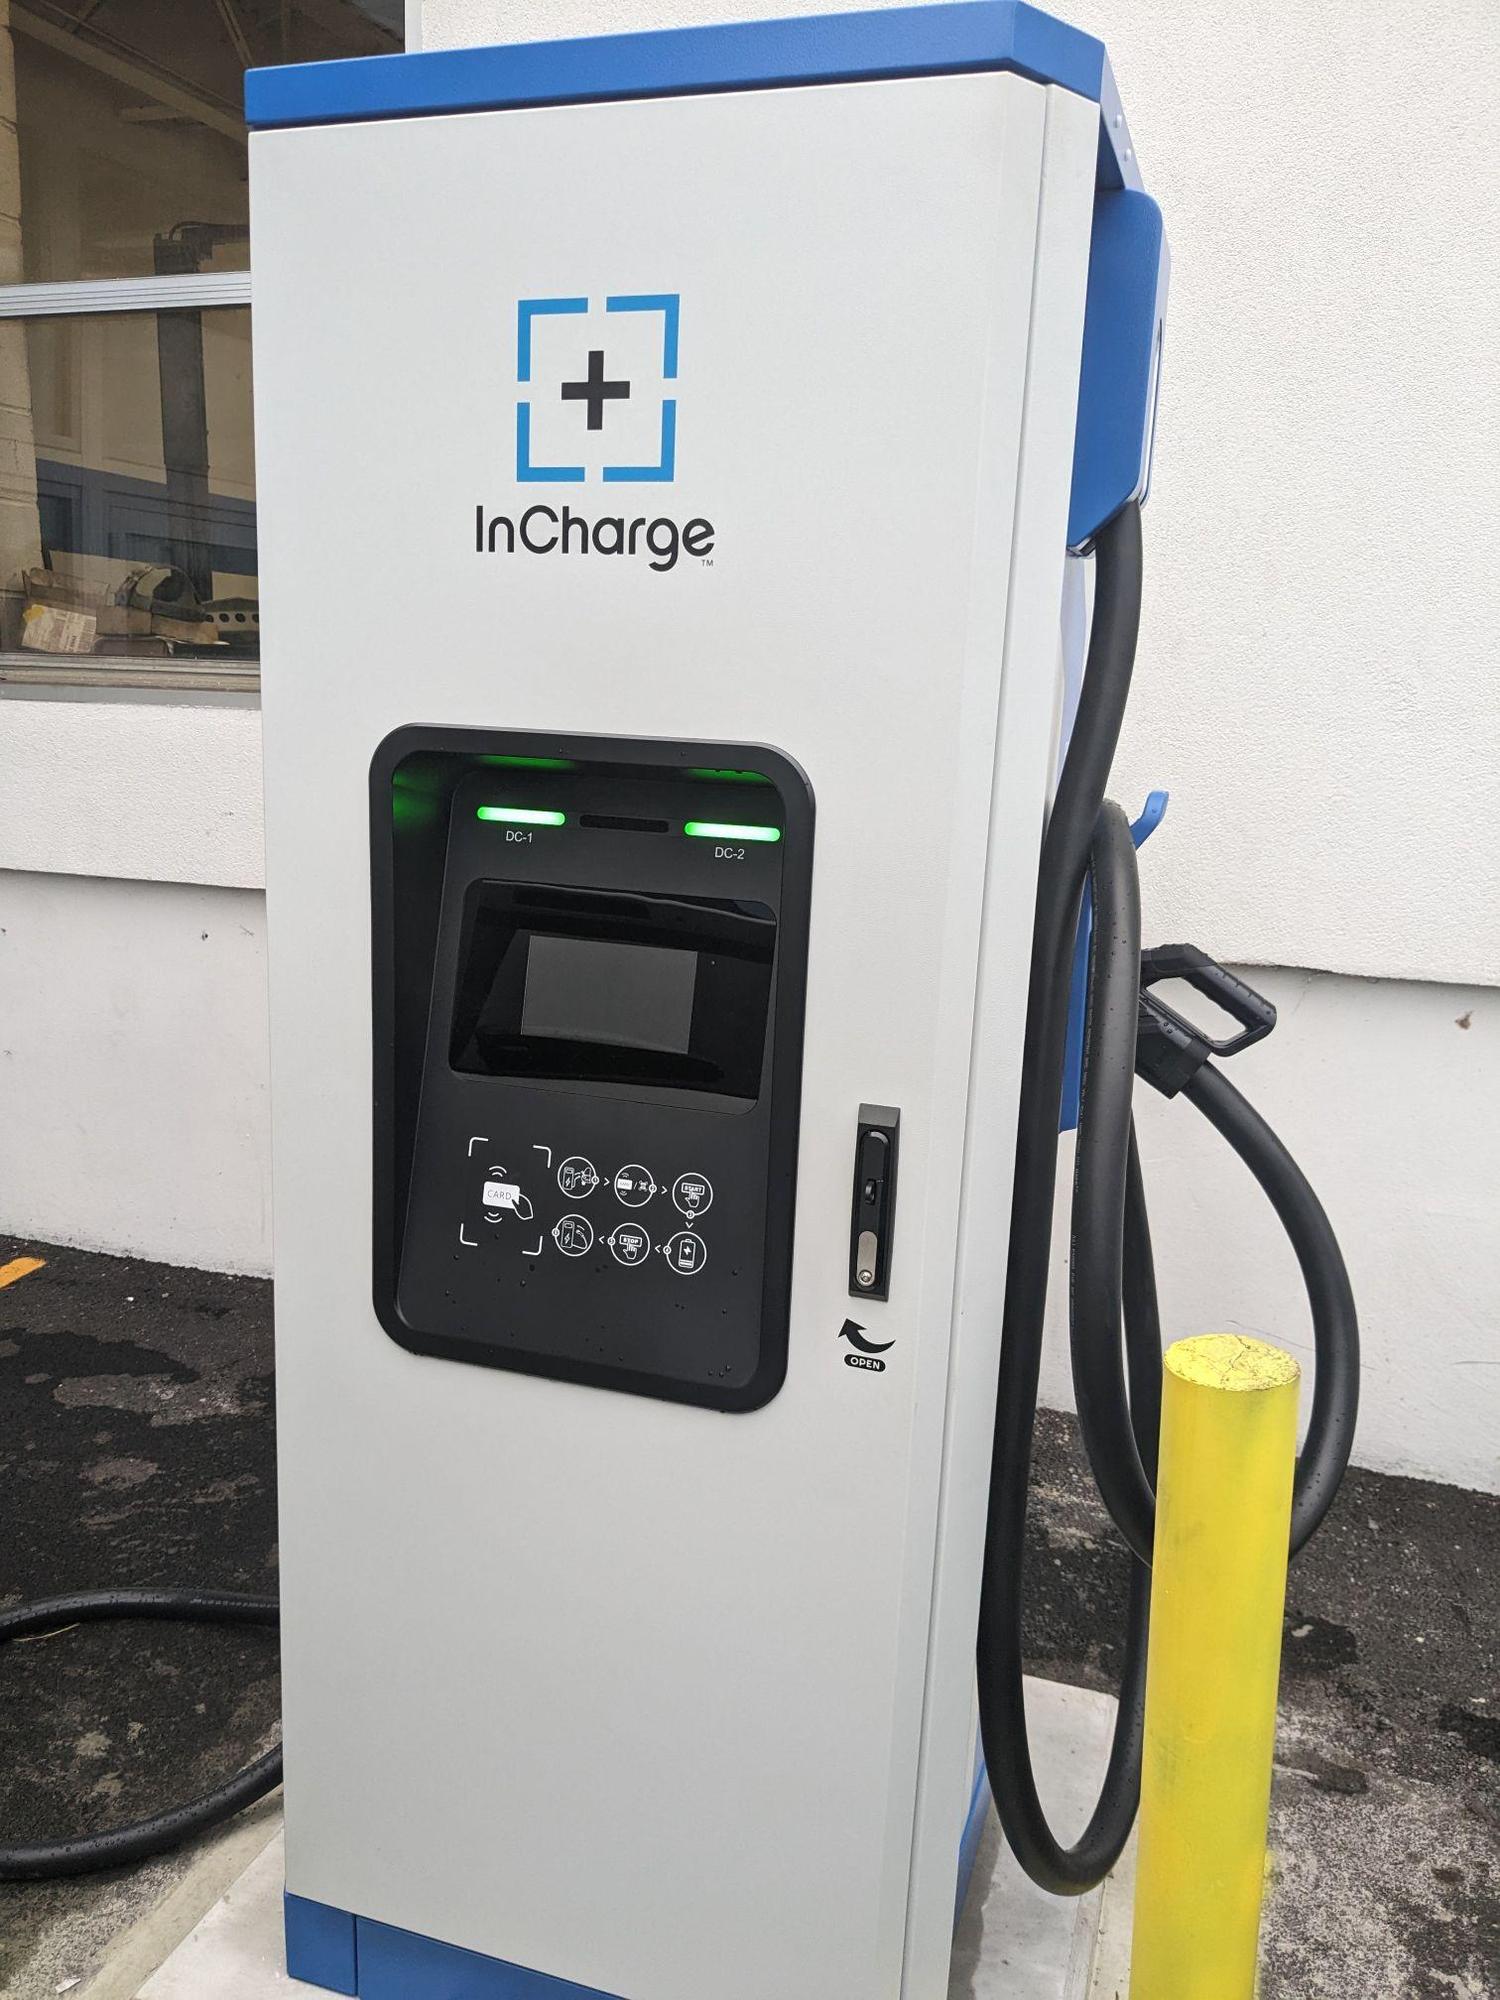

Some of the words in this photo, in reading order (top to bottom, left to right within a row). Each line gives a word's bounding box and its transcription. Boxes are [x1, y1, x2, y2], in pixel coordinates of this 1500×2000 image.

[476, 505, 715, 572] InCharge
[506, 830, 533, 843] DC-1
[714, 847, 745, 860] DC-2
[487, 1189, 512, 1201] CARD
[850, 1357, 880, 1370] OPEN
